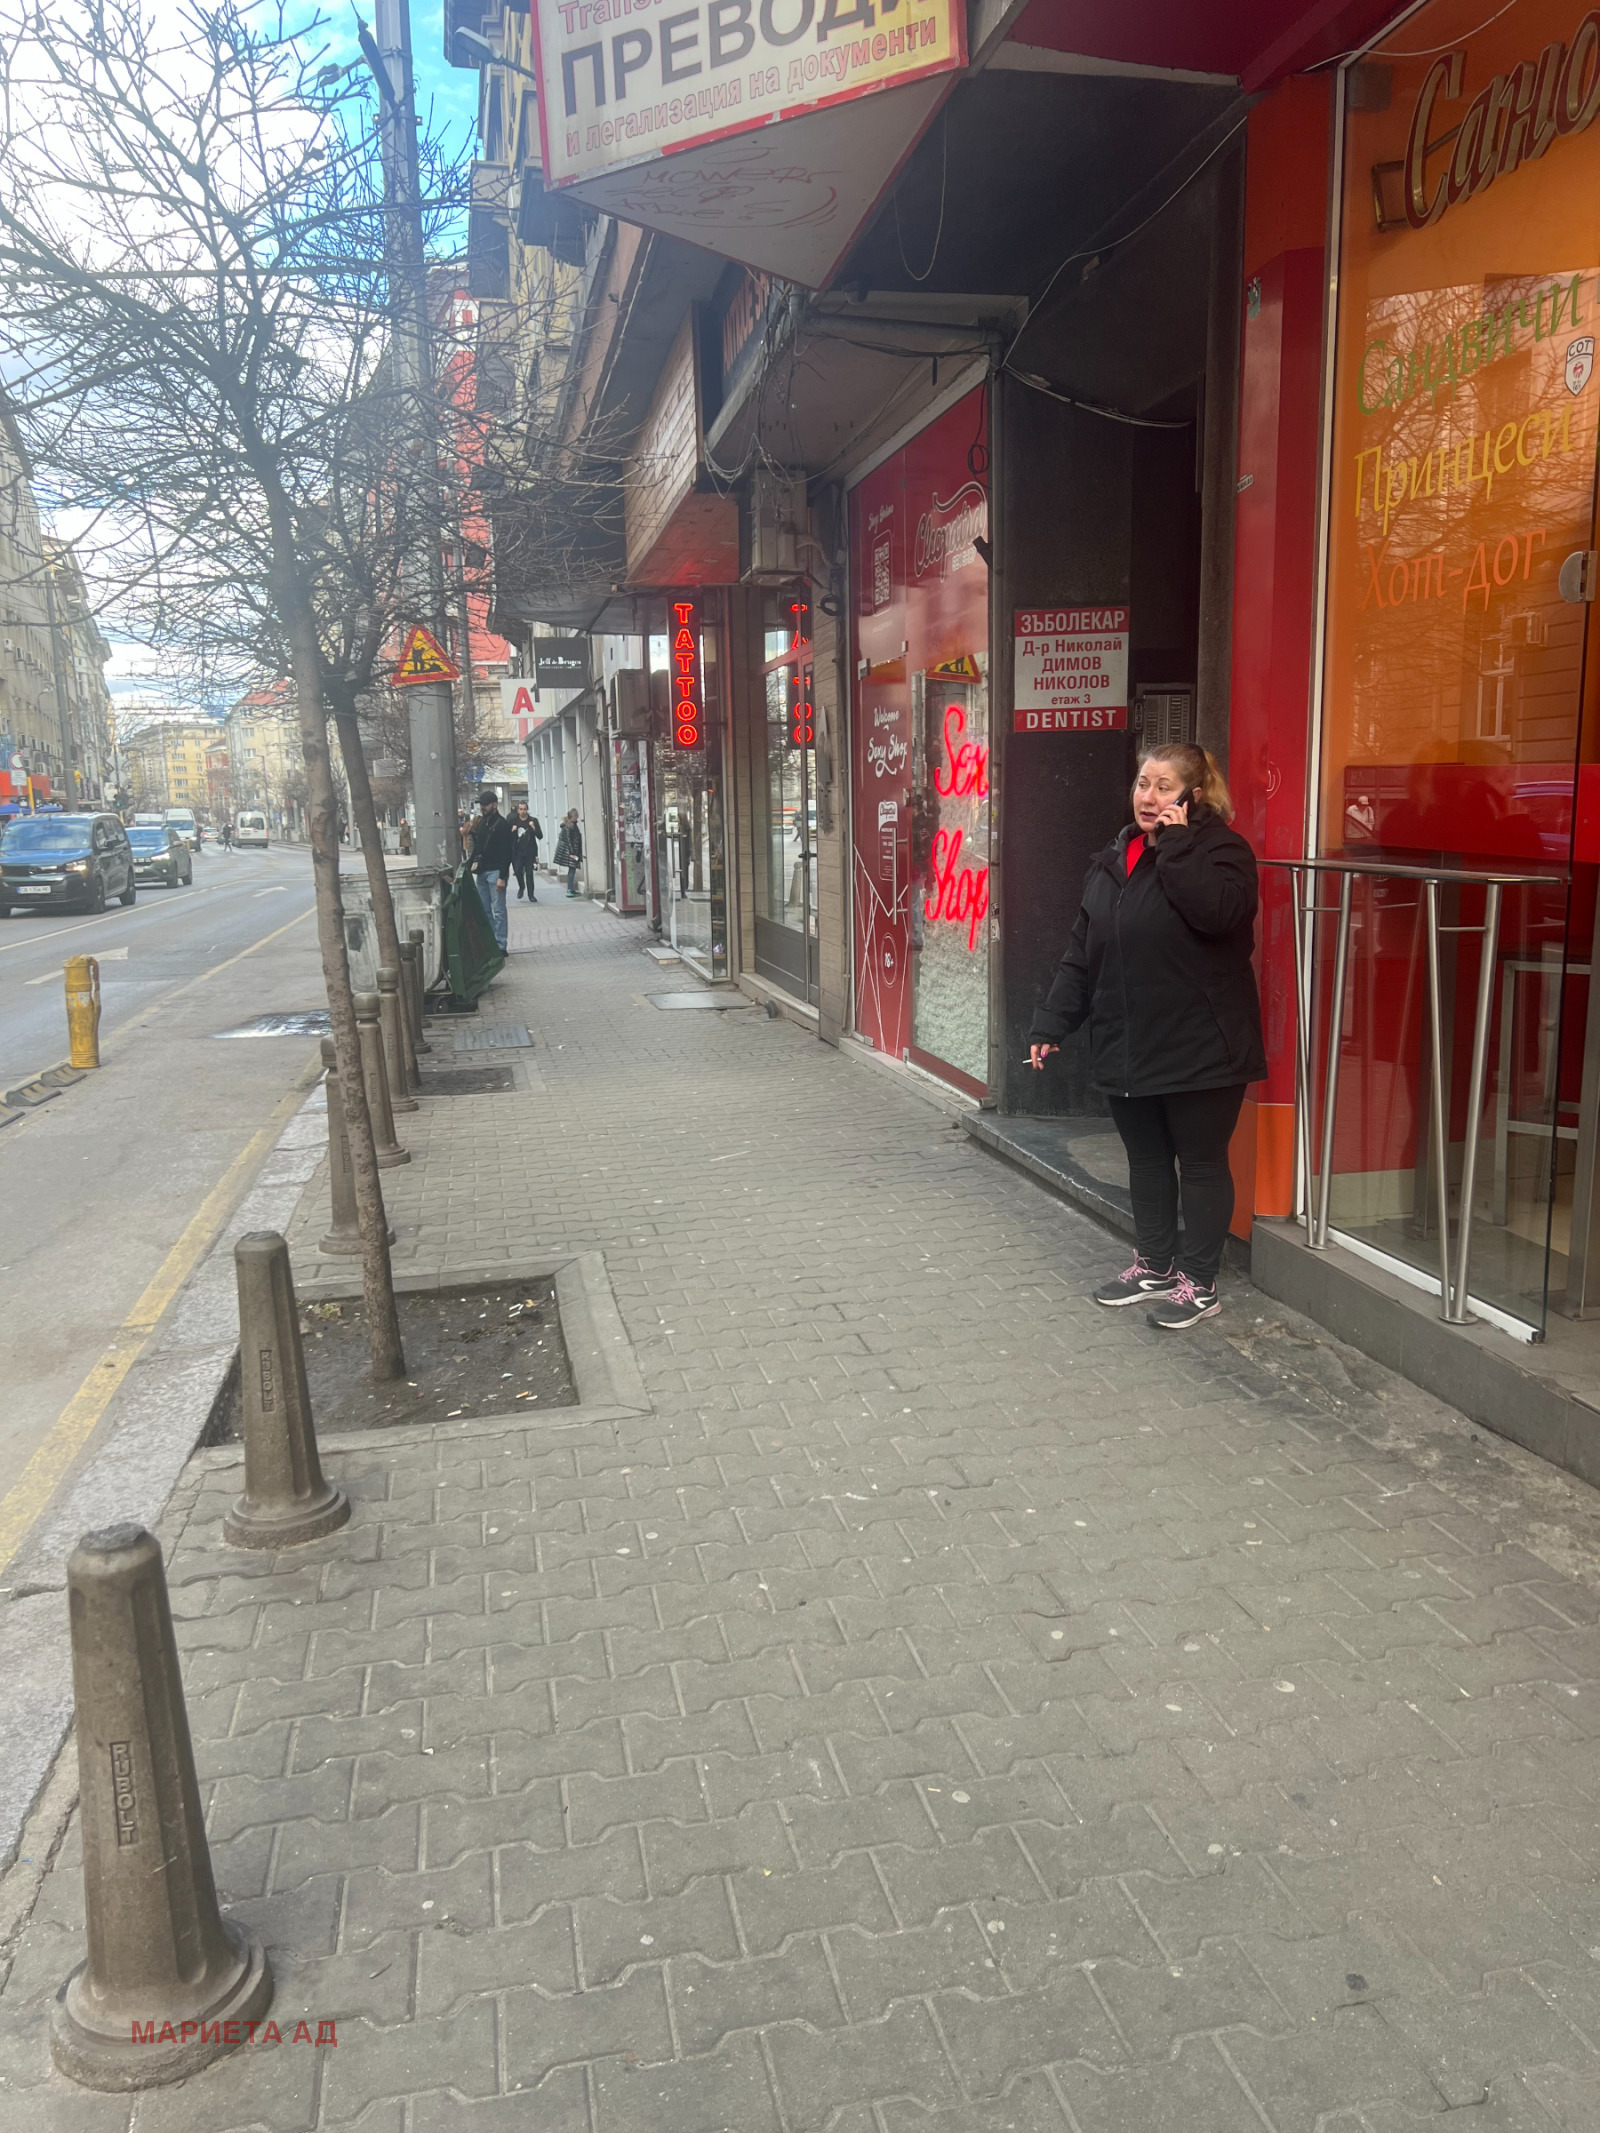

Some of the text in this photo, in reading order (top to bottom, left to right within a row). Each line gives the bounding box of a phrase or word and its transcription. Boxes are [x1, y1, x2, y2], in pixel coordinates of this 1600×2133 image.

[567, 16, 936, 157] и легализация на документи
[1357, 273, 1584, 416] Сандвичи
[1354, 403, 1574, 536] Принцеси
[1360, 529, 1546, 615] Хот-дог
[1021, 611, 1125, 633] ЗЪБОЛЕКАР
[1022, 637, 1123, 657] Д-р Николай
[674, 603, 698, 745] TATTOO
[1042, 656, 1102, 674] ДИМОВ
[1034, 674, 1110, 690] НИКОЛОВ
[512, 683, 540, 714] A1
[1051, 693, 1091, 705] етаж 3
[874, 705, 900, 727] Welcome
[1026, 709, 1117, 729] DENTIST
[924, 827, 989, 951] Shop
[112, 1743, 137, 1846] RUBOLT
